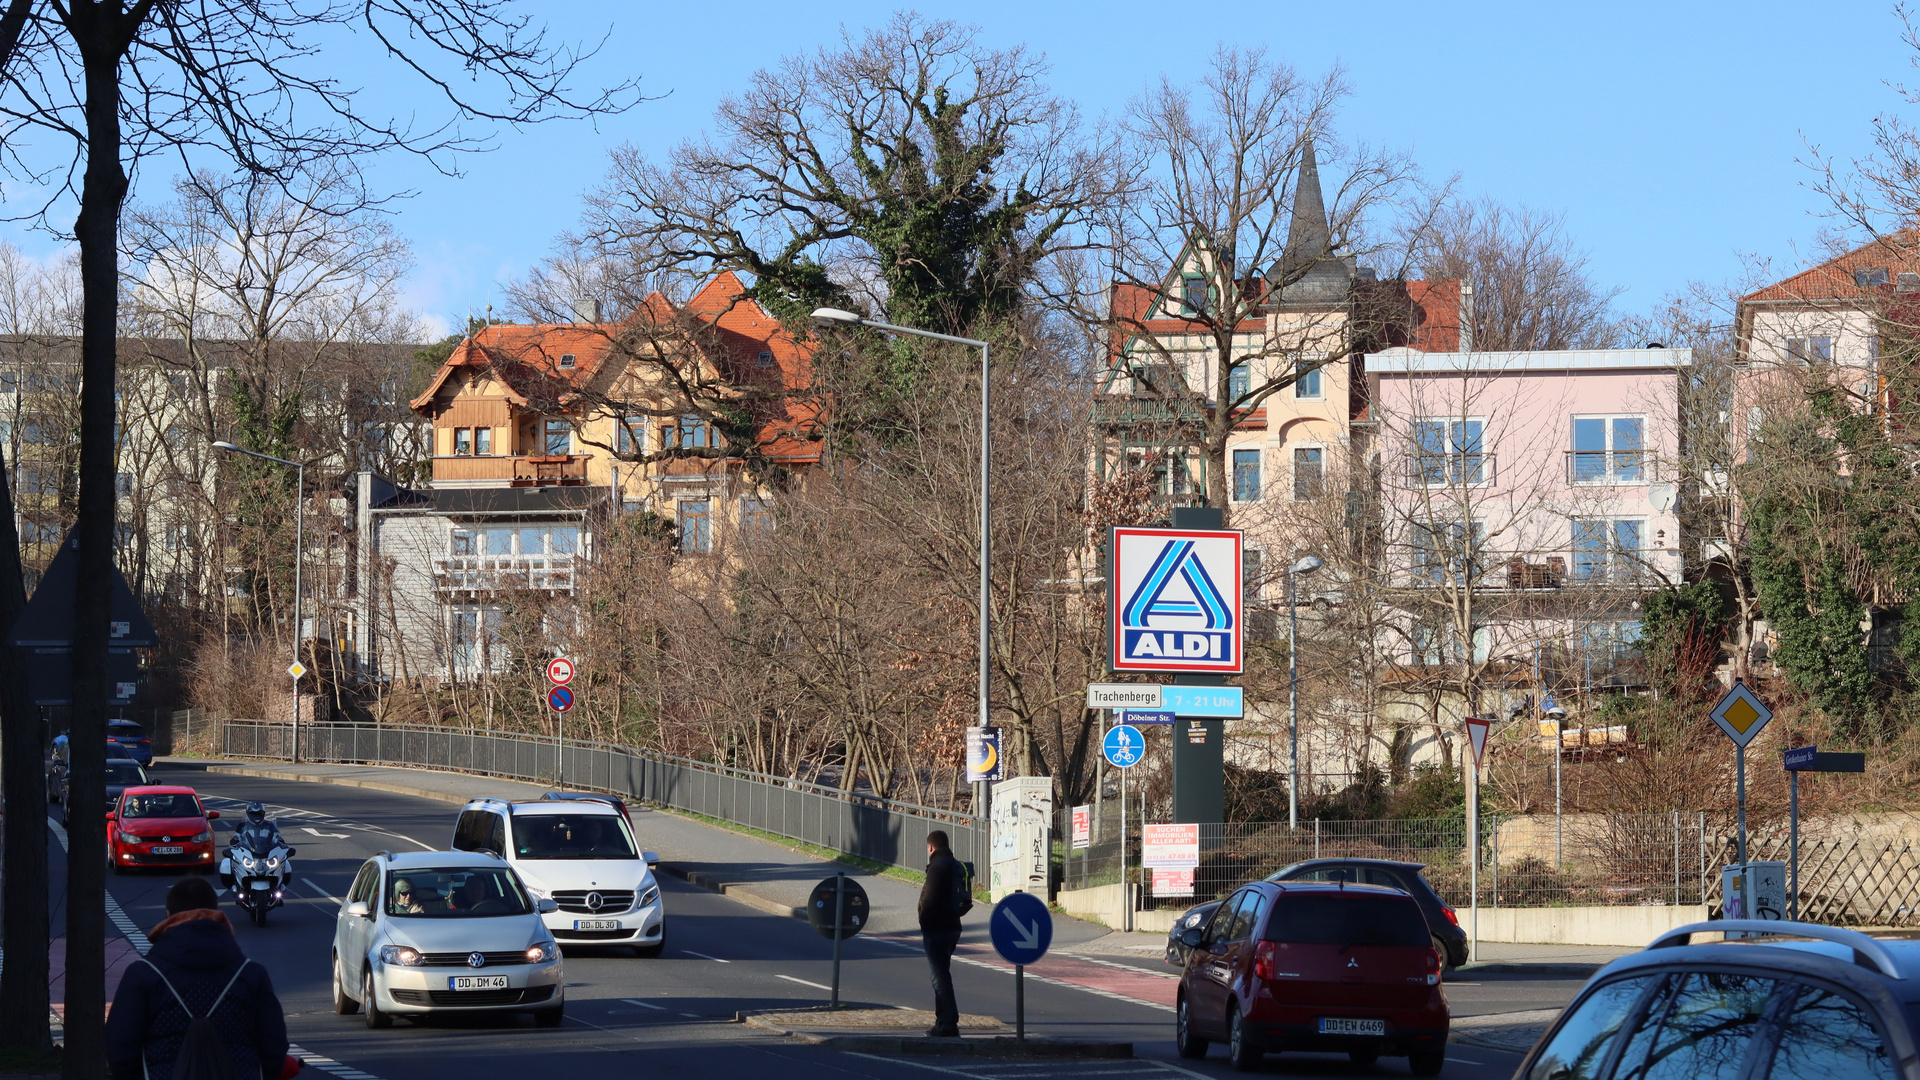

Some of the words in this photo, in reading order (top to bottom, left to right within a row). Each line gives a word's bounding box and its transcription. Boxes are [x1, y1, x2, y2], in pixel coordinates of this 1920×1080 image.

[1131, 632, 1222, 659] ALDI
[1094, 690, 1157, 705] Trachenberge
[1175, 695, 1183, 707] 7
[1194, 695, 1208, 707] 21
[1213, 696, 1236, 708] Uhr
[1127, 713, 1157, 722] Döbelner
[1159, 713, 1171, 722] Str.
[580, 921, 591, 929] DD
[595, 921, 604, 929] DL
[605, 921, 615, 929] 30
[458, 978, 471, 988] DD
[477, 978, 490, 988] DM
[492, 977, 505, 987] 46
[1325, 1019, 1338, 1031] DD
[1344, 1020, 1357, 1032] EW
[1360, 1020, 1384, 1032] 6469
